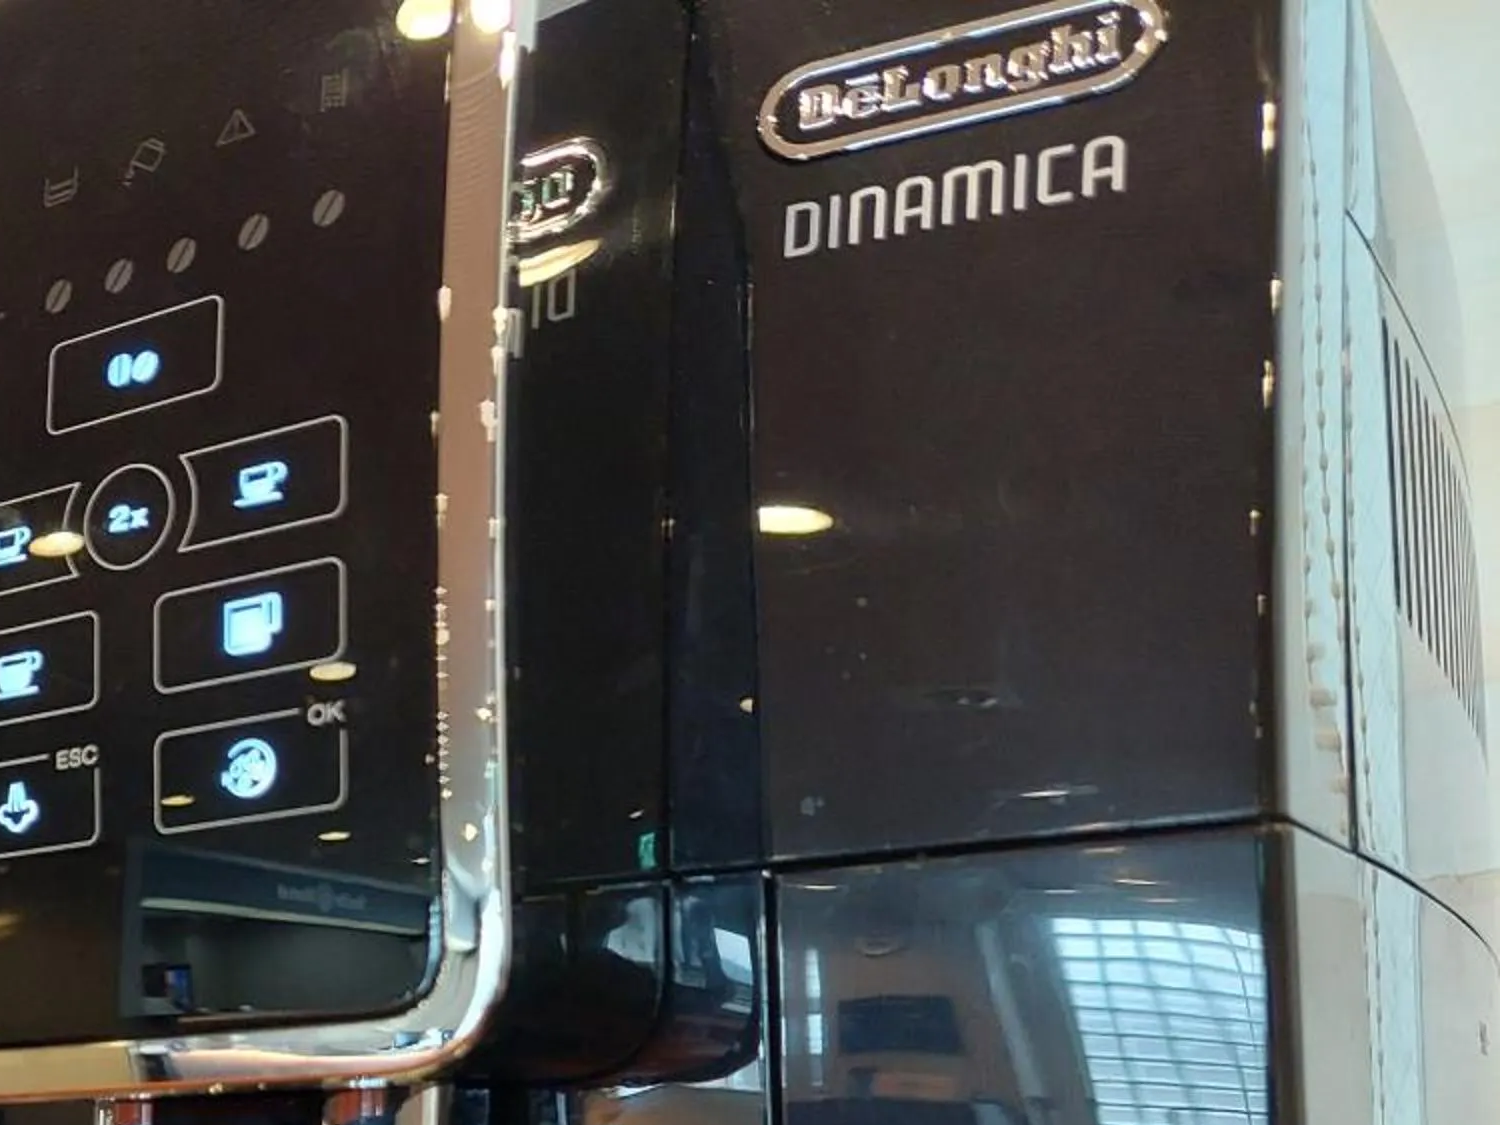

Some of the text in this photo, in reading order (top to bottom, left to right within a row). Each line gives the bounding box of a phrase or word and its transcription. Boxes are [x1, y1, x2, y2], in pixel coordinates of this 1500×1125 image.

[783, 135, 1128, 259] DINAMICA
[108, 504, 149, 533] 2x
[306, 700, 346, 726] OK
[55, 745, 98, 770] ESC
